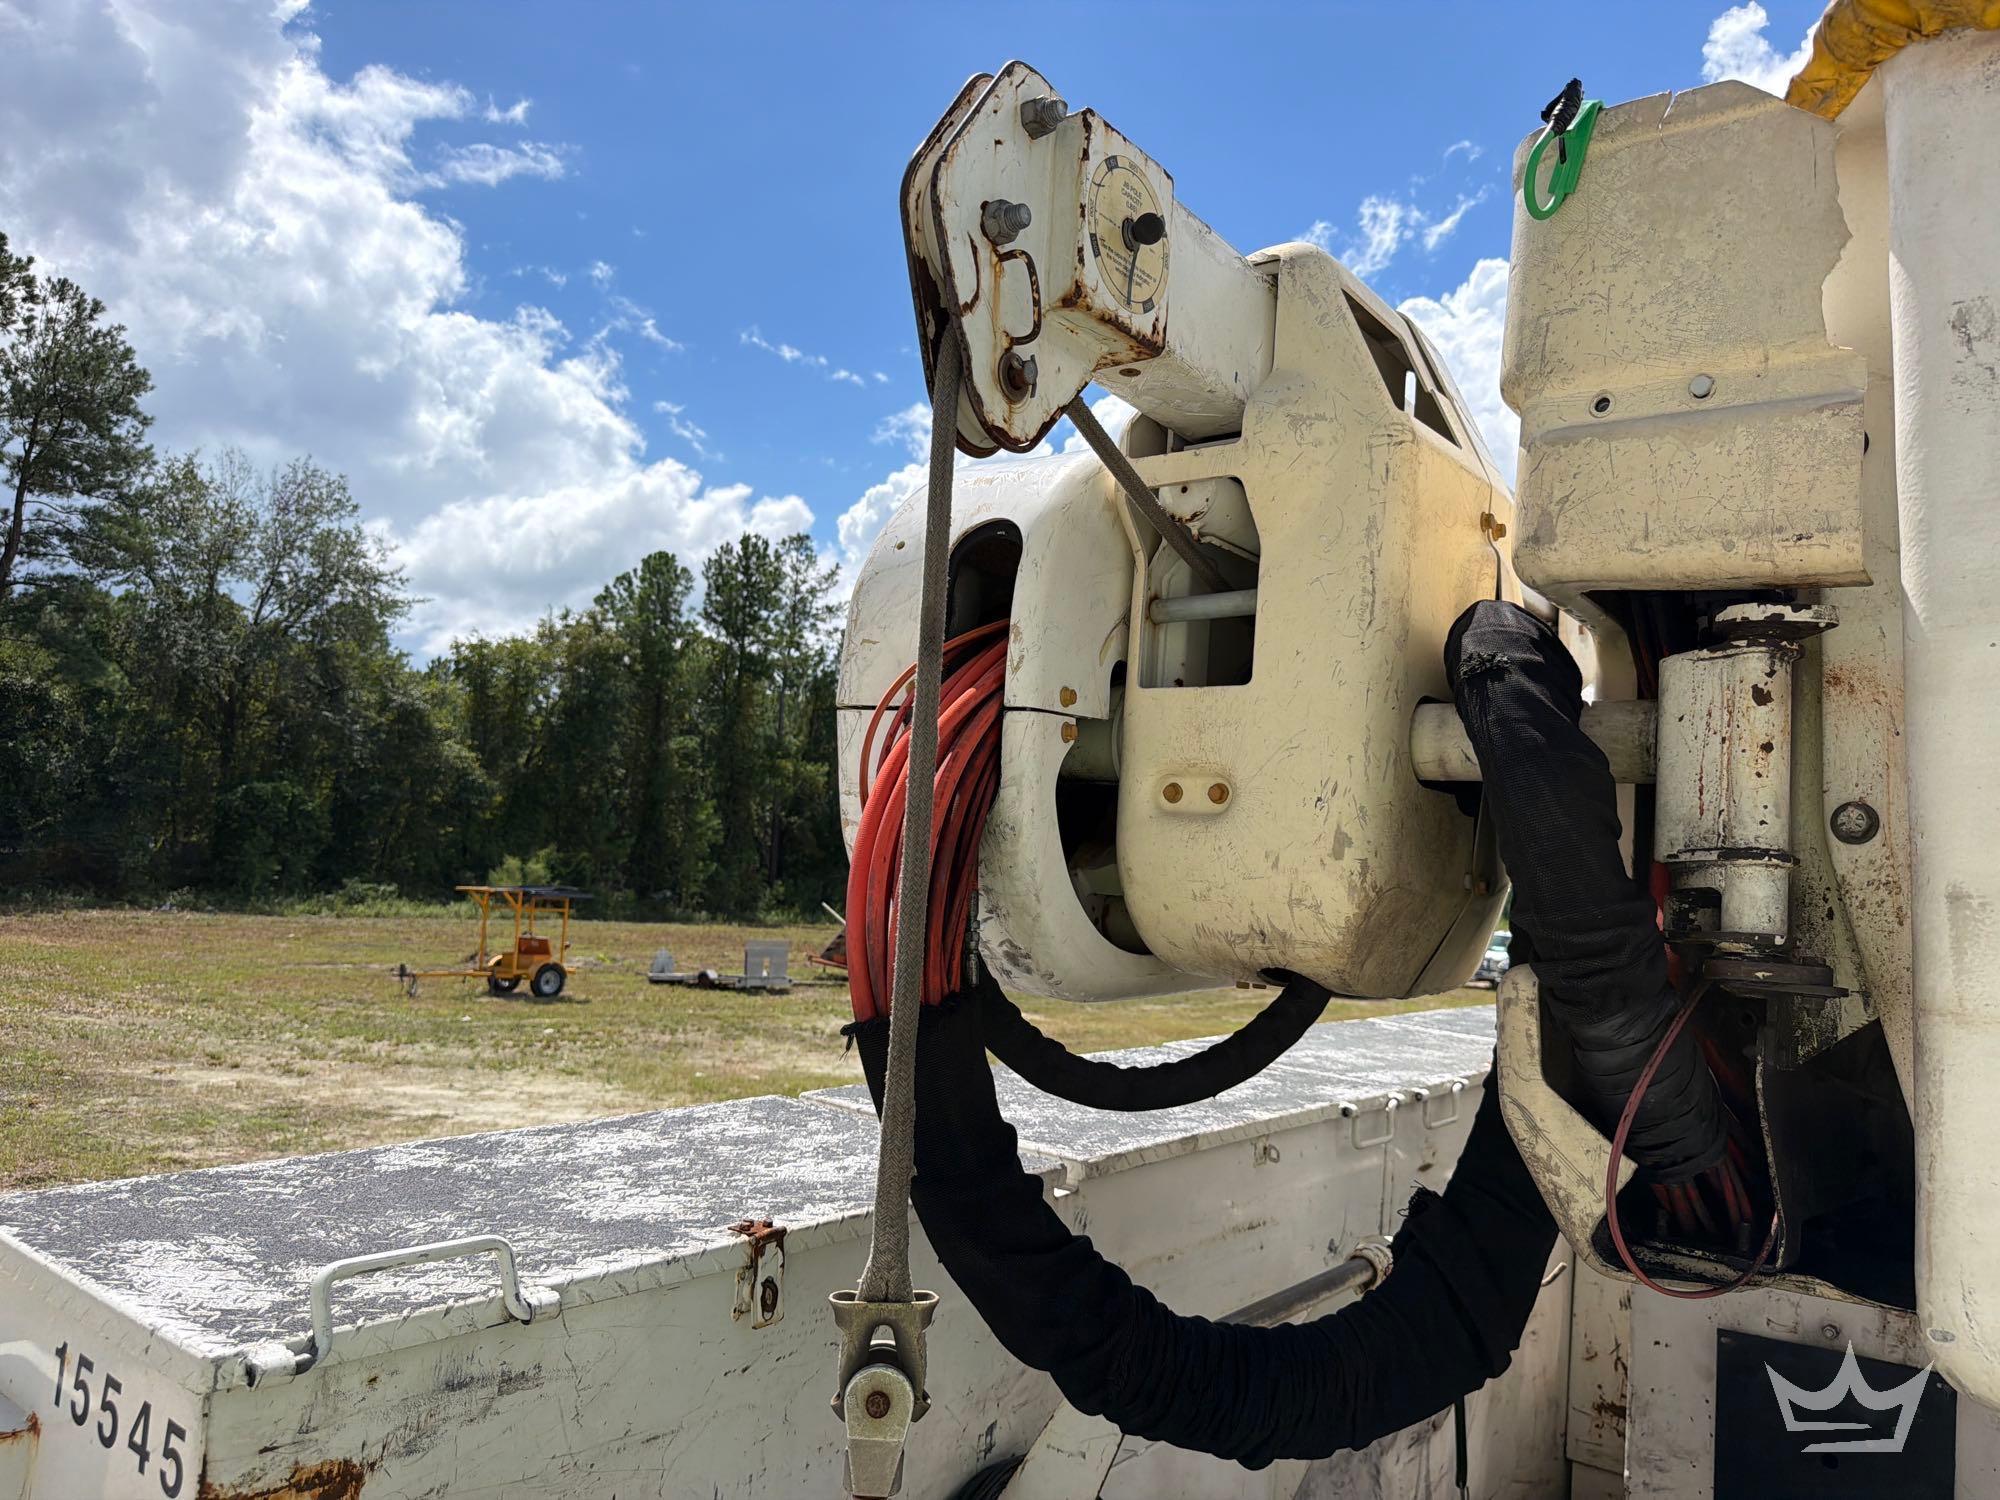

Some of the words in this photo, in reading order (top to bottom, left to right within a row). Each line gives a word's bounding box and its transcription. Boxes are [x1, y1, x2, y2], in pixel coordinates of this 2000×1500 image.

[1121, 188, 1143, 208] CAPACITY
[1130, 185, 1143, 200] POLE
[54, 1341, 187, 1499] 15545
